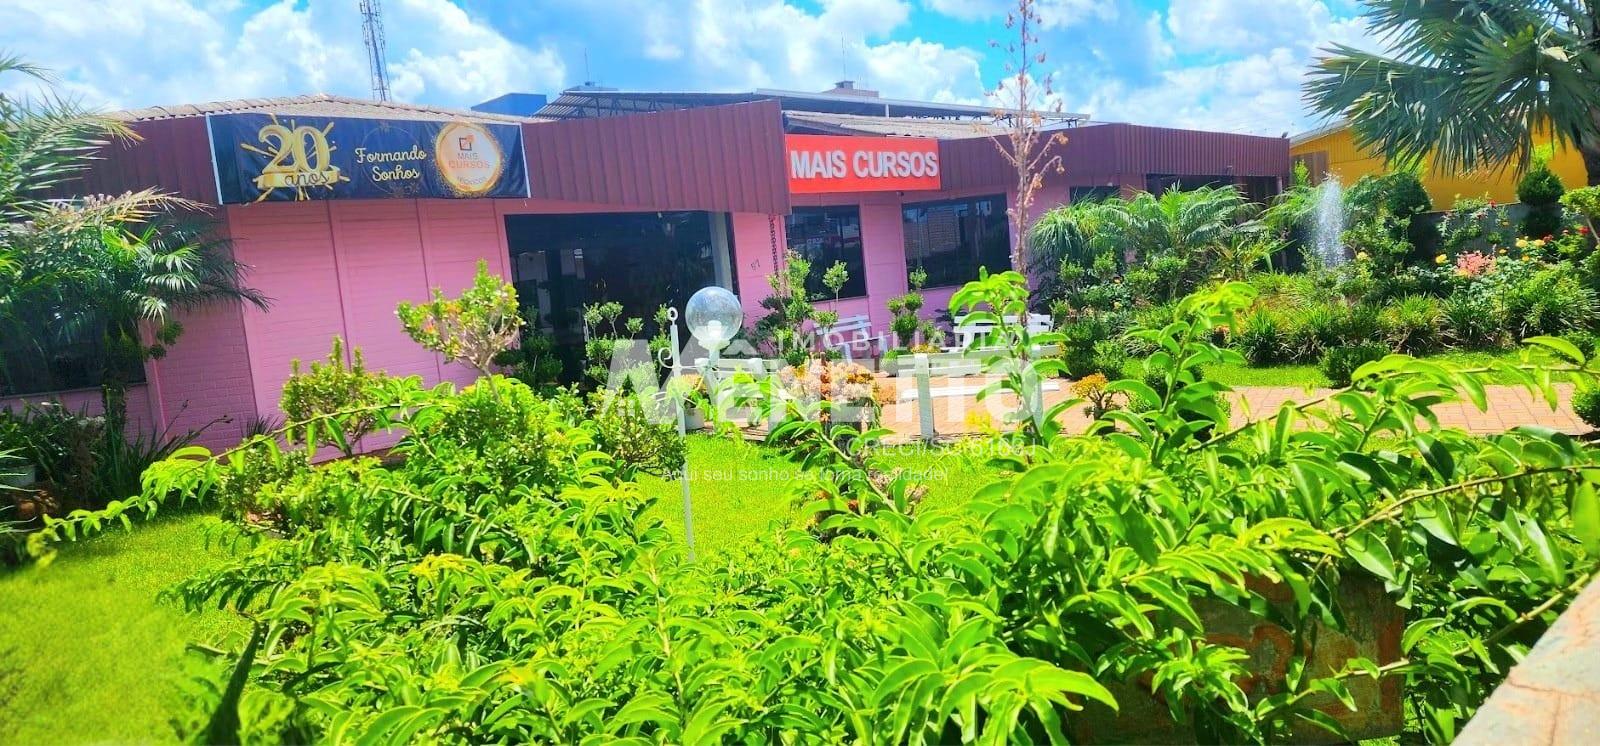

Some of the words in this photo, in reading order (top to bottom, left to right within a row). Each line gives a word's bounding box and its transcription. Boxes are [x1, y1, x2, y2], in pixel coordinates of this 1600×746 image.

[259, 124, 331, 174] 20
[355, 145, 427, 164] Formando
[448, 160, 490, 169] CURSOS
[790, 150, 847, 178] MAIS
[853, 150, 938, 178] CURSOS
[284, 171, 330, 187] anos
[372, 165, 421, 182] Sonhos
